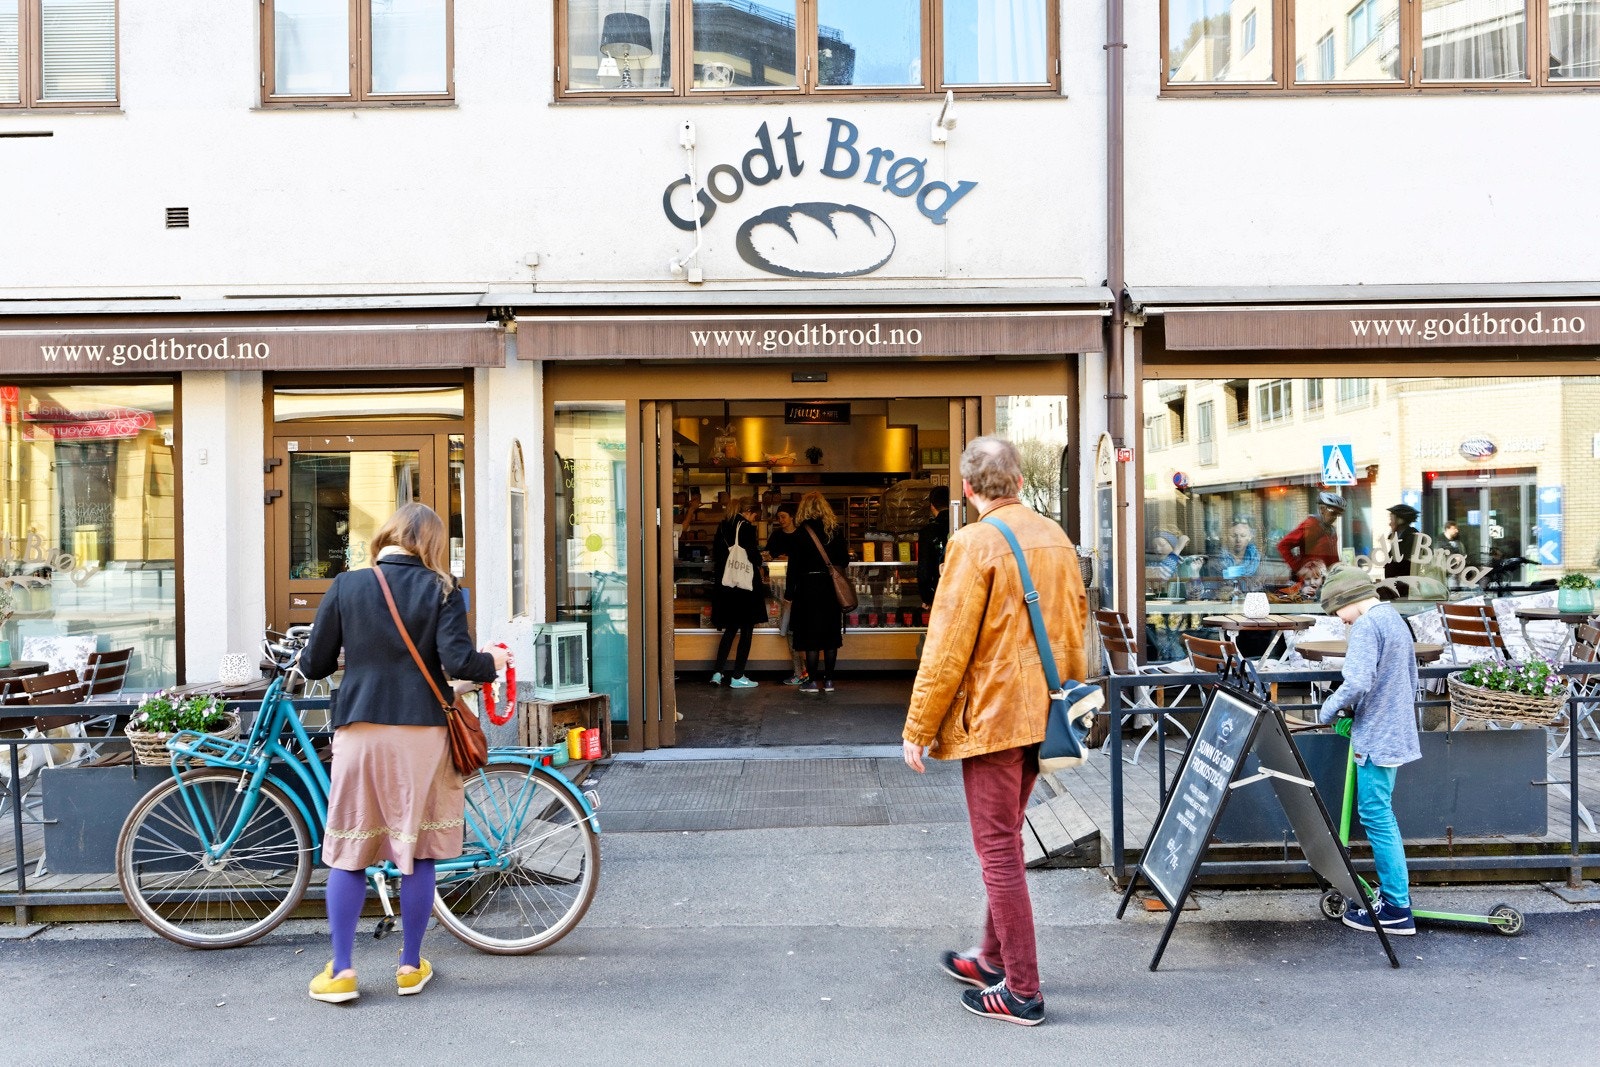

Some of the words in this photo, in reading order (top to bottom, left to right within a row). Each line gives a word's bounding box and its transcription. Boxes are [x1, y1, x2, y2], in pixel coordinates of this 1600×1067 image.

[662, 116, 804, 231] Godt
[820, 117, 978, 225] Brød
[690, 323, 922, 351] www.godtbrod.no
[1350, 311, 1586, 341] www.godtbrod.no
[40, 337, 270, 366] www.godtbrod.no
[22, 527, 100, 588] Brød
[727, 559, 751, 574] HOPE
[1356, 531, 1404, 574] odt
[1411, 532, 1494, 587] Brød
[1198, 740, 1214, 760] SUNN
[1212, 749, 1223, 764] OG
[1219, 752, 1235, 773] GOD
[1190, 756, 1227, 791] FROKOSTDEAL
